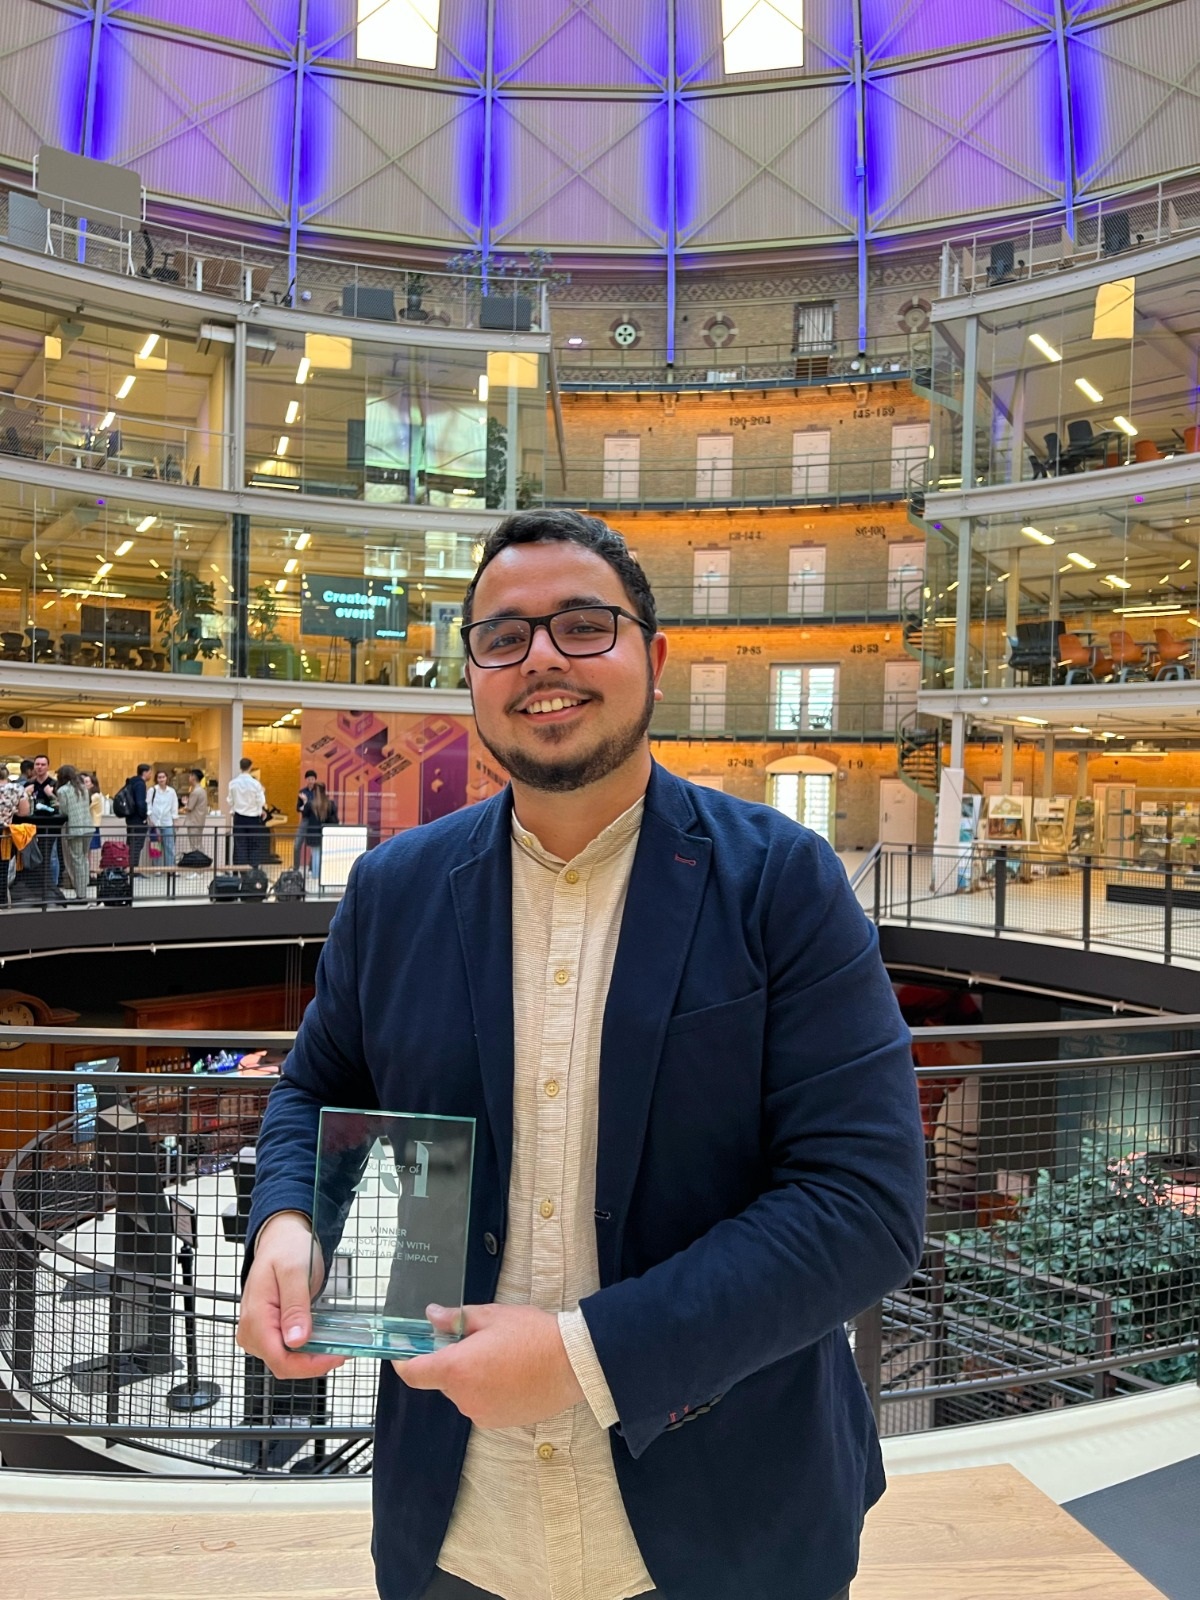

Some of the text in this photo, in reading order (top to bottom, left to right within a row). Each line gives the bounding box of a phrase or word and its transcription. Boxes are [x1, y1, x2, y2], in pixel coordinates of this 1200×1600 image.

[322, 590, 368, 605] Create
[335, 607, 375, 620] event
[409, 1164, 421, 1174] of
[370, 1225, 407, 1237] WINNER
[358, 1238, 404, 1248] SOLUTION
[406, 1240, 431, 1250] WITH
[336, 1246, 439, 1263] QUANTIFABLE IMPACT
